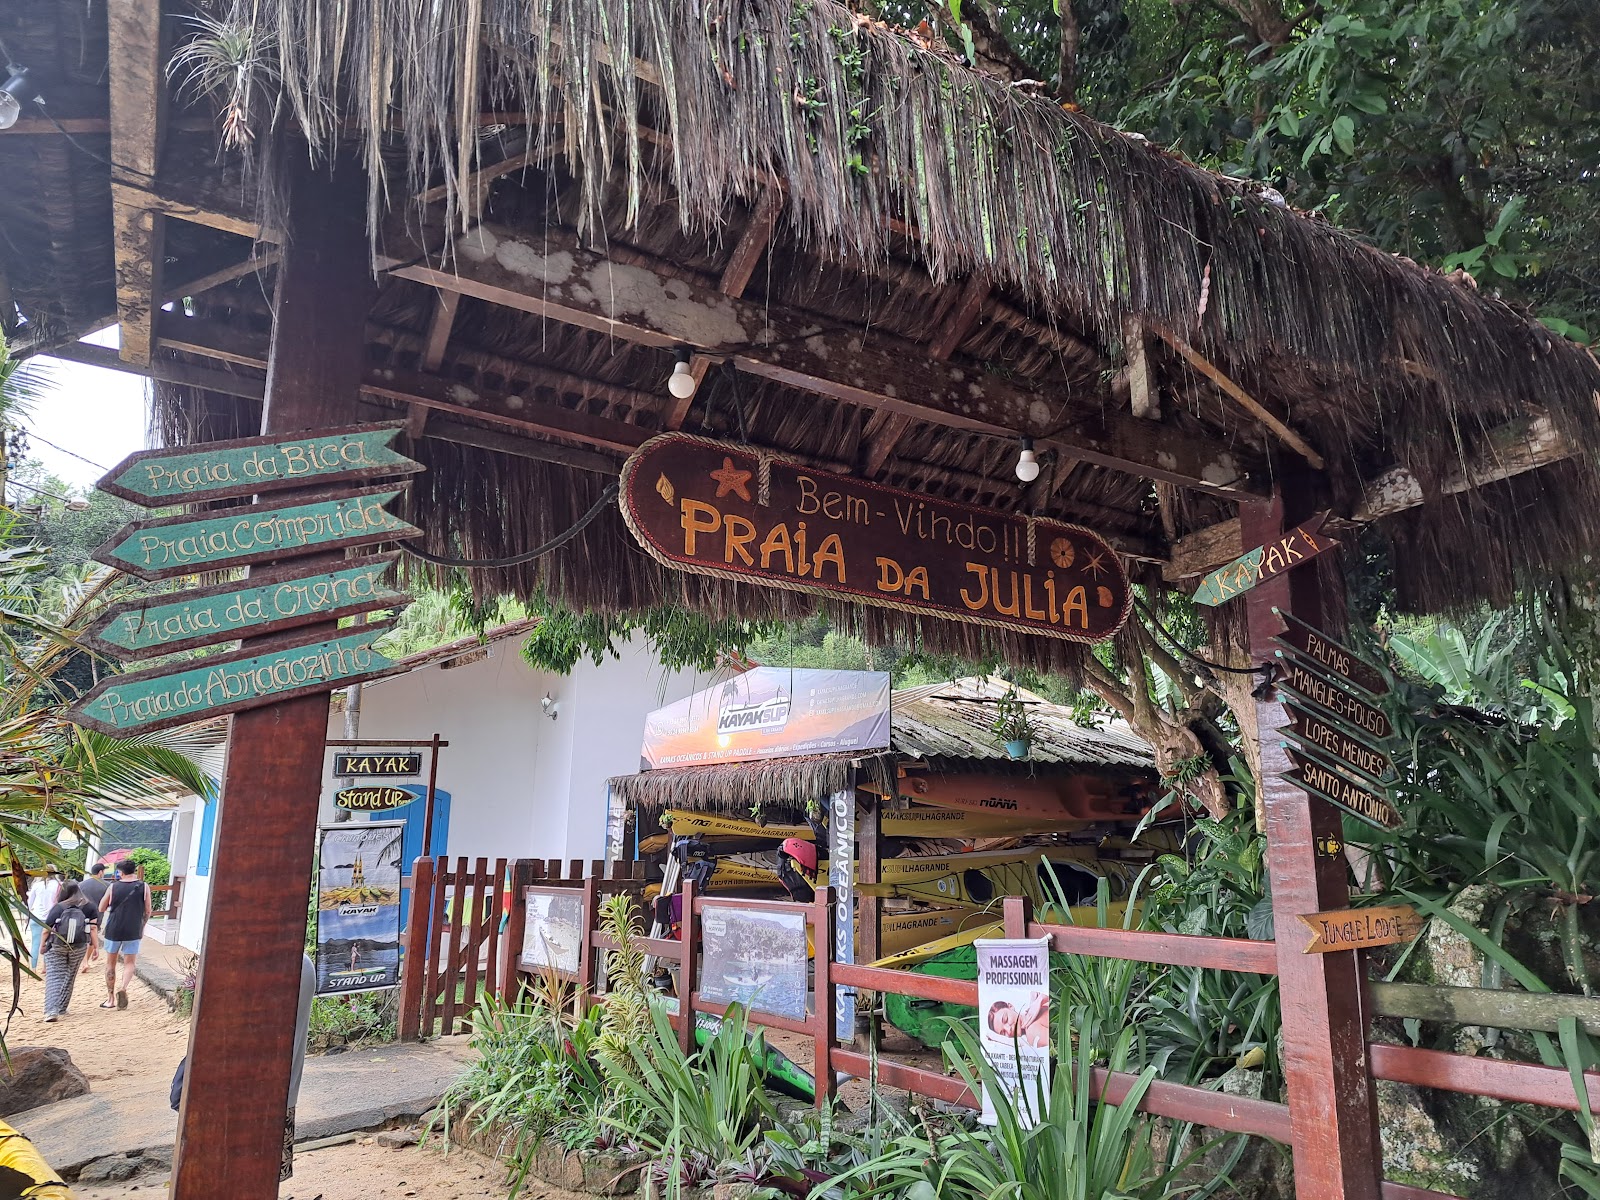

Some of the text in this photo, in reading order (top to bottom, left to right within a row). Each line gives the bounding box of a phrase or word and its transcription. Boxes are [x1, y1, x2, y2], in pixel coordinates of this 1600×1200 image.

[146, 441, 377, 490] Praia da Bica
[139, 499, 398, 564] Praia Comprida
[876, 556, 931, 600] DA
[1214, 535, 1303, 600] KAYAK
[123, 572, 384, 644] Praia da Crena
[1307, 633, 1350, 676] PALMAS
[100, 643, 373, 726] Praia do Abraãozinho
[346, 757, 410, 773] KAYAK
[1305, 718, 1384, 778] LOPES MENDES
[337, 788, 382, 809] Stand
[1303, 763, 1340, 798] SANTO
[882, 863, 950, 873] KSUPILHAGRANDE
[328, 973, 386, 988] STAND UP
[836, 928, 848, 1022] KAKS
[985, 971, 1042, 986] PROFISSIONAL
[990, 955, 1037, 969] MASSAGEM
